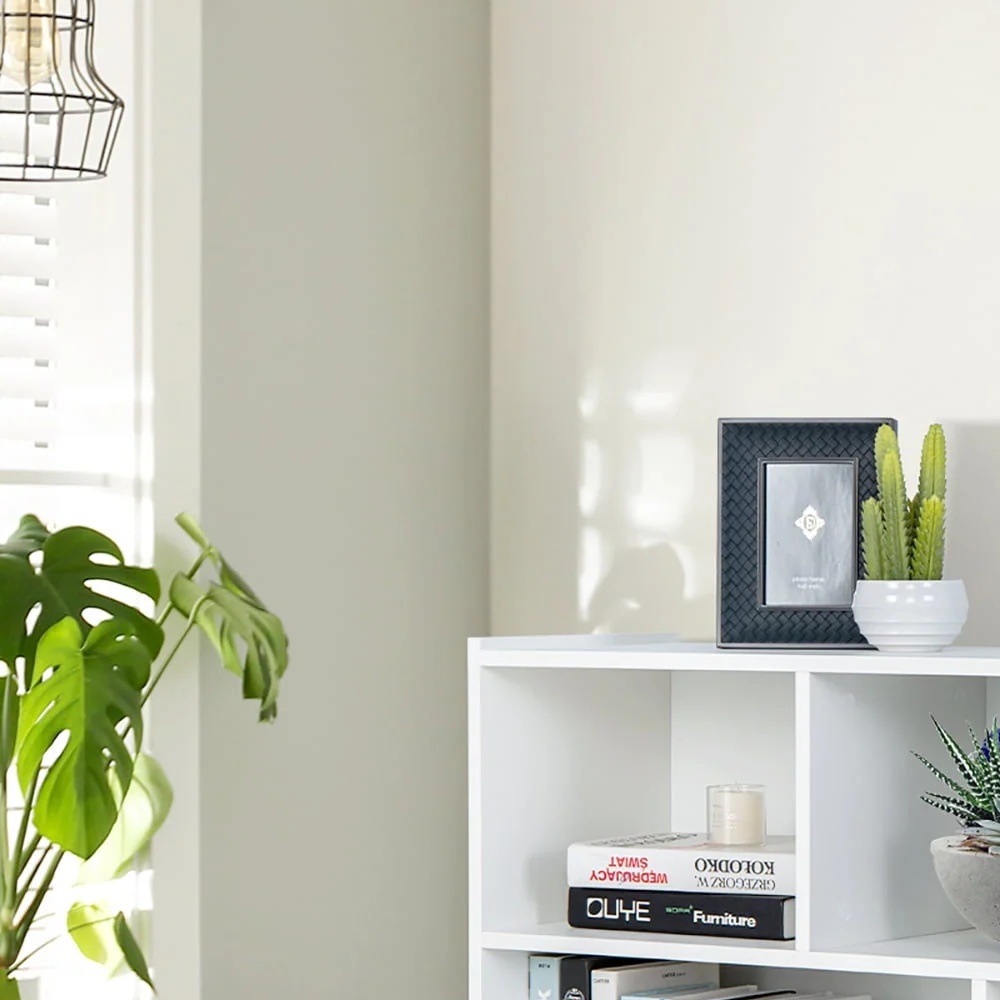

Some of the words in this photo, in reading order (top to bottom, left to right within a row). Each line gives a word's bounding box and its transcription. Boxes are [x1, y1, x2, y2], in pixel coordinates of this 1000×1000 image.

[608, 855, 649, 872] ŚWIAT
[694, 857, 776, 875] KOŁODKO
[589, 868, 669, 884] WĘDRUJĄCY
[709, 876, 776, 892] GRZEGORZ
[692, 909, 757, 928] Furniture
